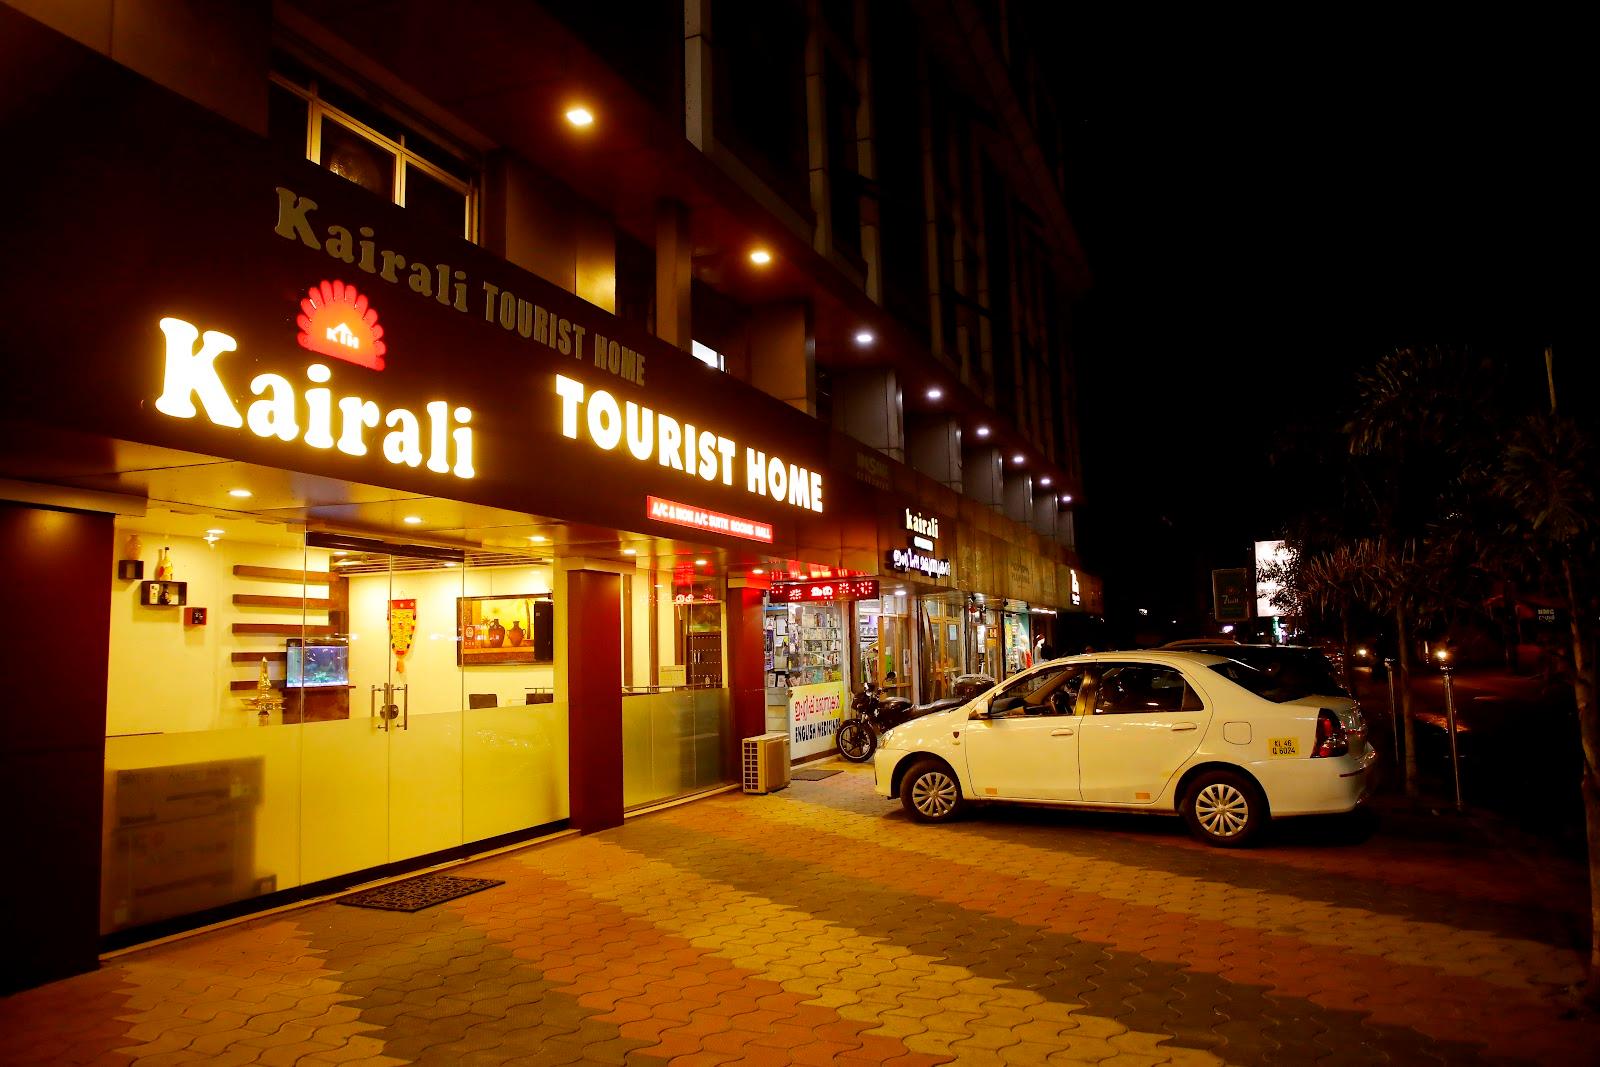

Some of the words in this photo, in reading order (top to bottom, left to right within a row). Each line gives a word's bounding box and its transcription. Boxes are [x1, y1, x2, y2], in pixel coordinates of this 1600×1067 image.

[274, 186, 468, 313] Kairali
[483, 281, 586, 361] TOURIST
[594, 333, 646, 387] HOME
[155, 317, 476, 480] Kairali
[555, 373, 736, 486] TOURIST
[746, 447, 823, 514] HOME
[905, 508, 939, 539] kairali
[795, 723, 816, 744] ENGLISH
